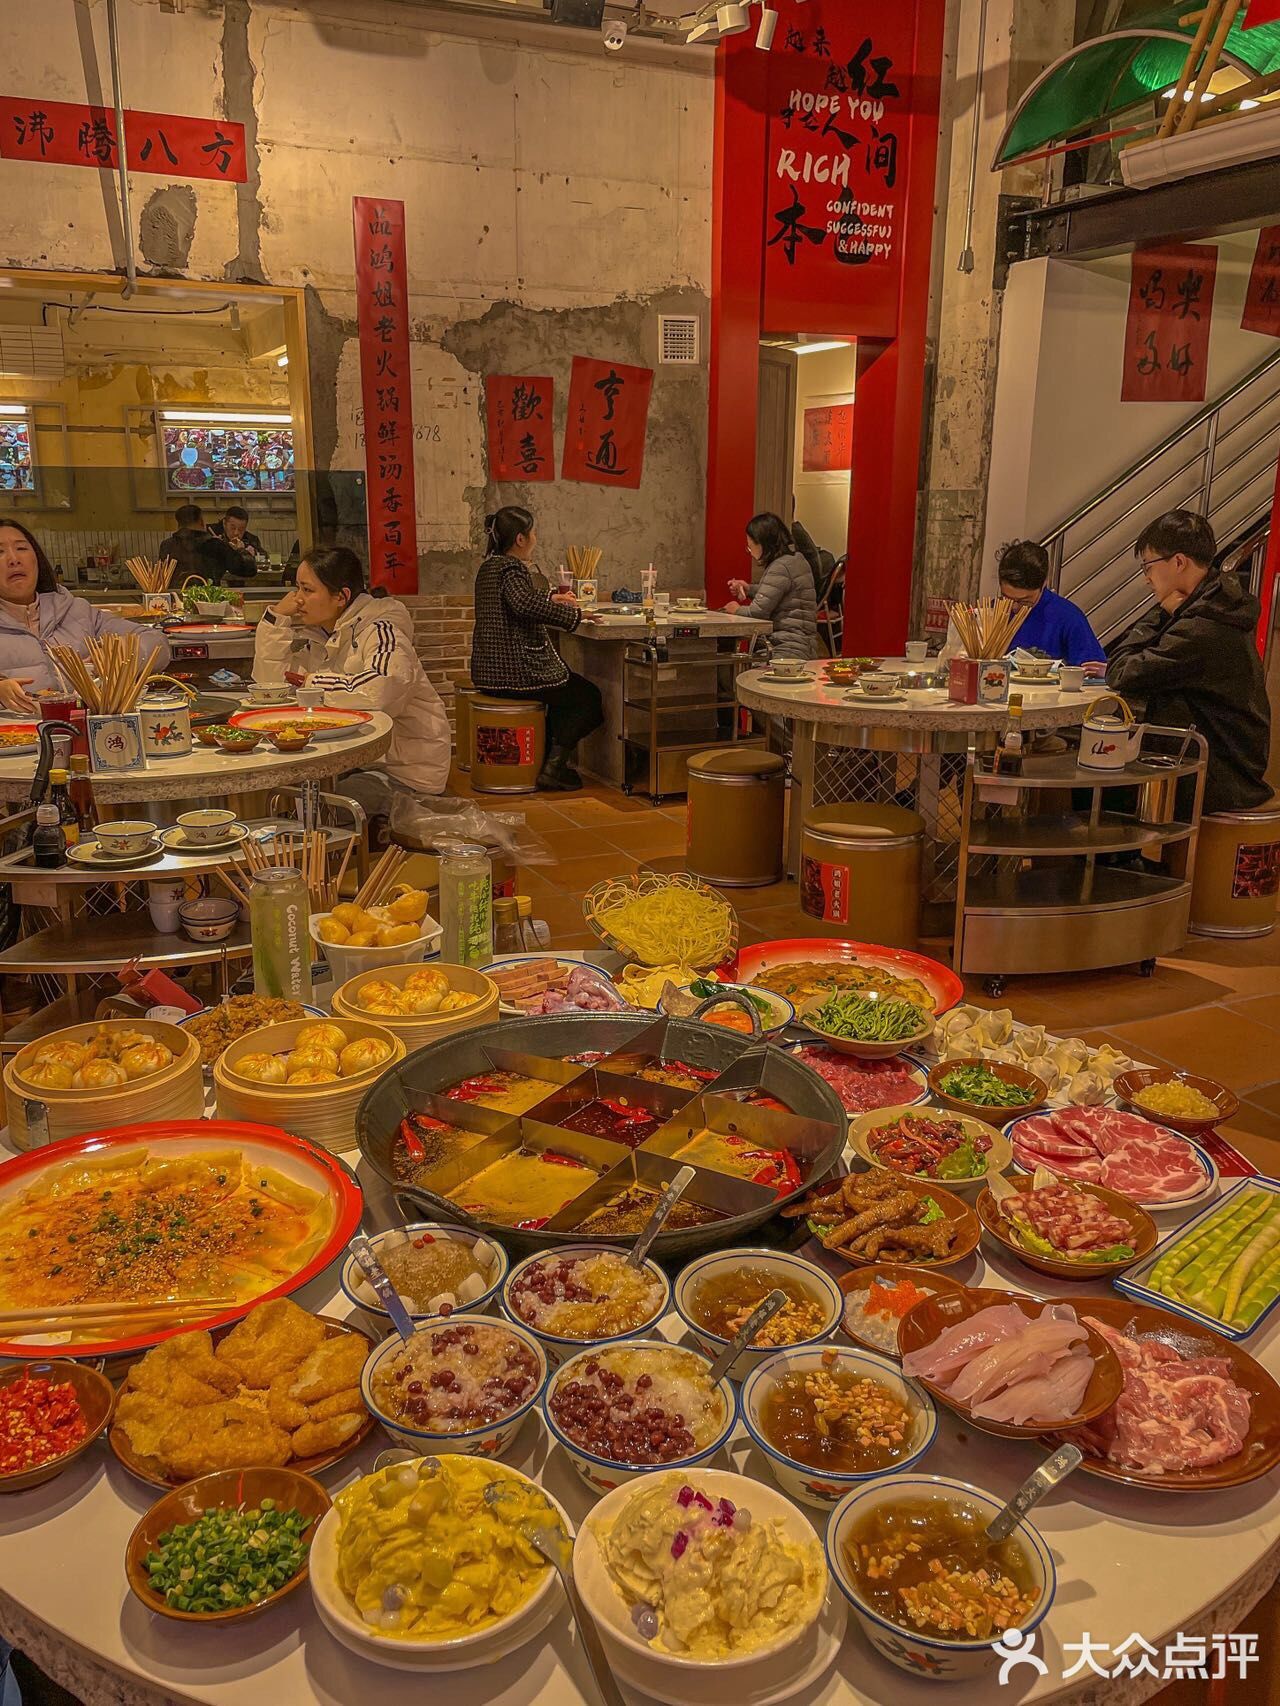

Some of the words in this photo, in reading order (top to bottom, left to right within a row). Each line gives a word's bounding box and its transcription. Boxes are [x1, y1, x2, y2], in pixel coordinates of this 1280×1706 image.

[789, 88, 841, 114] HOPE
[847, 96, 884, 124] YOU
[13, 110, 234, 174] 沸腾八方
[776, 148, 851, 188] RICH
[826, 200, 894, 220] CONFIDENT
[107, 735, 125, 751] 鸿
[286, 904, 300, 954] Coconut
[290, 956, 303, 997] Water
